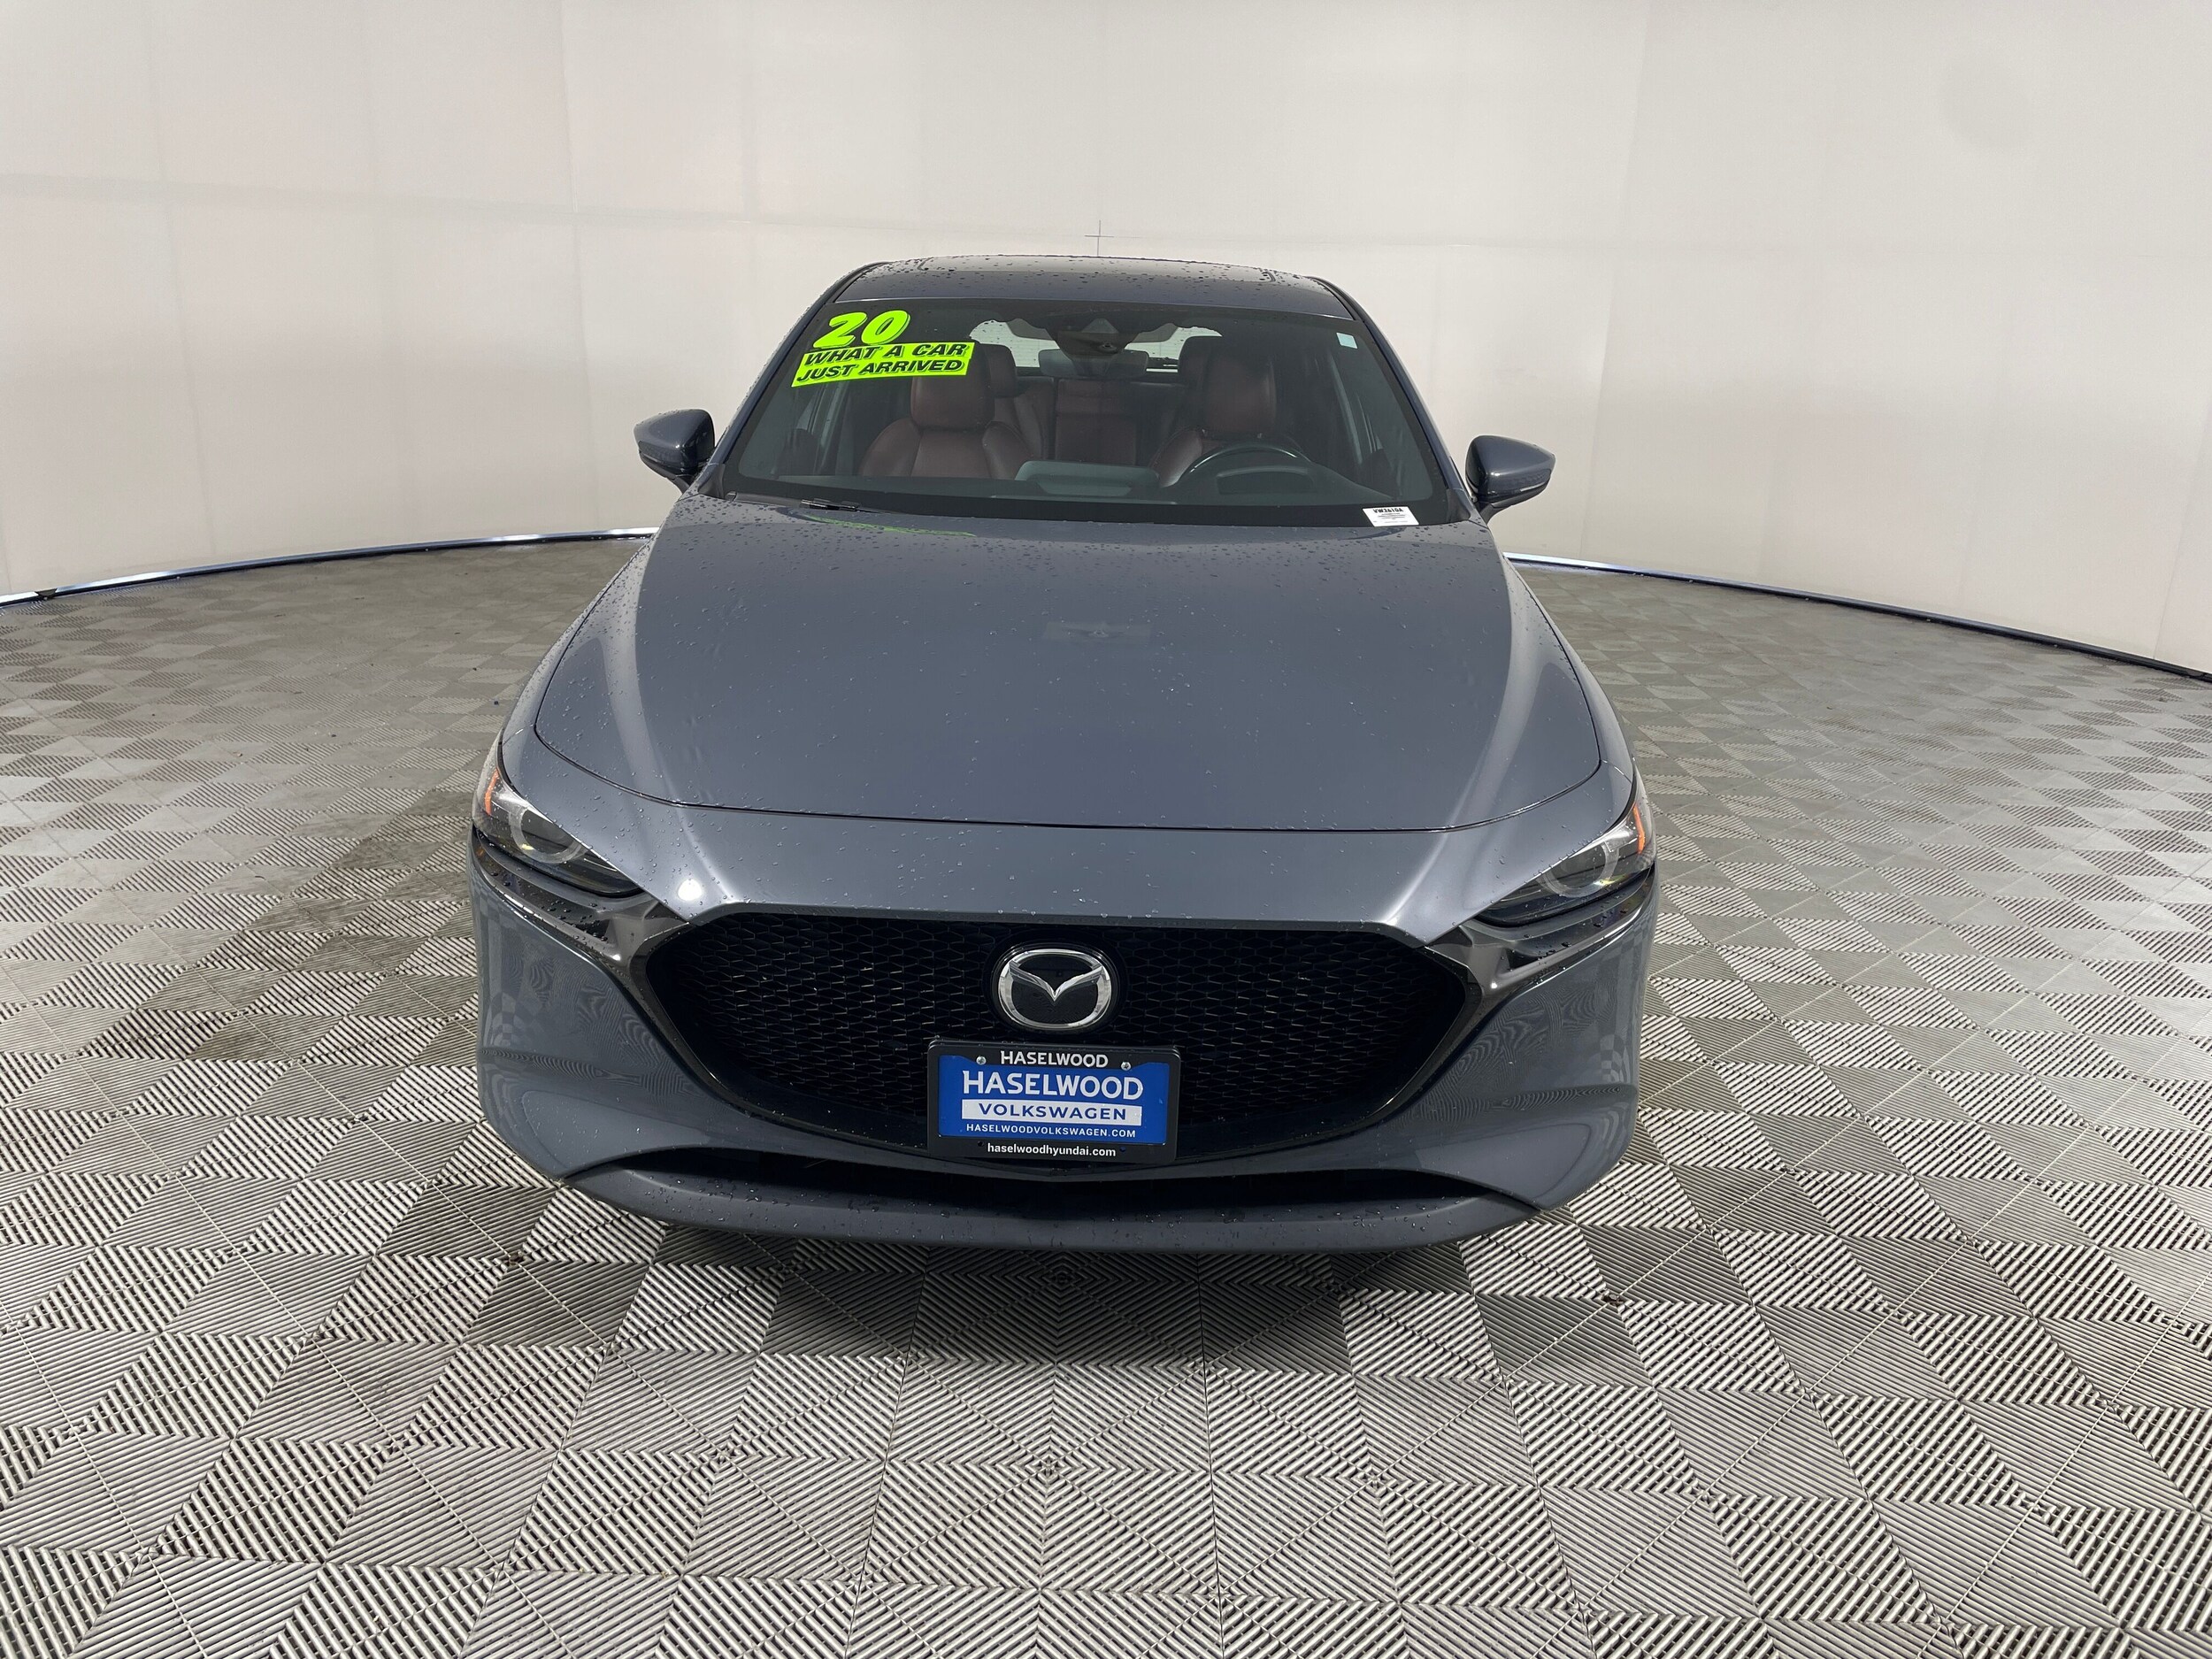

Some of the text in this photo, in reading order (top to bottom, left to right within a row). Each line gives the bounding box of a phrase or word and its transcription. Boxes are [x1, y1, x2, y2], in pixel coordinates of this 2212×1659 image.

[813, 310, 910, 349] 20
[804, 343, 969, 365] WHAT A CAR
[796, 359, 964, 381] JUST ARRIVED
[1000, 1050, 1109, 1068] HASELWOOD
[962, 1070, 1144, 1100] HASELWOOD
[978, 1102, 1126, 1121] VOLKSWAGEN
[966, 1123, 1136, 1138] HASELWOODVOLKSWAGEN.COM
[987, 1142, 1117, 1157] haselwoodhyundai.com
